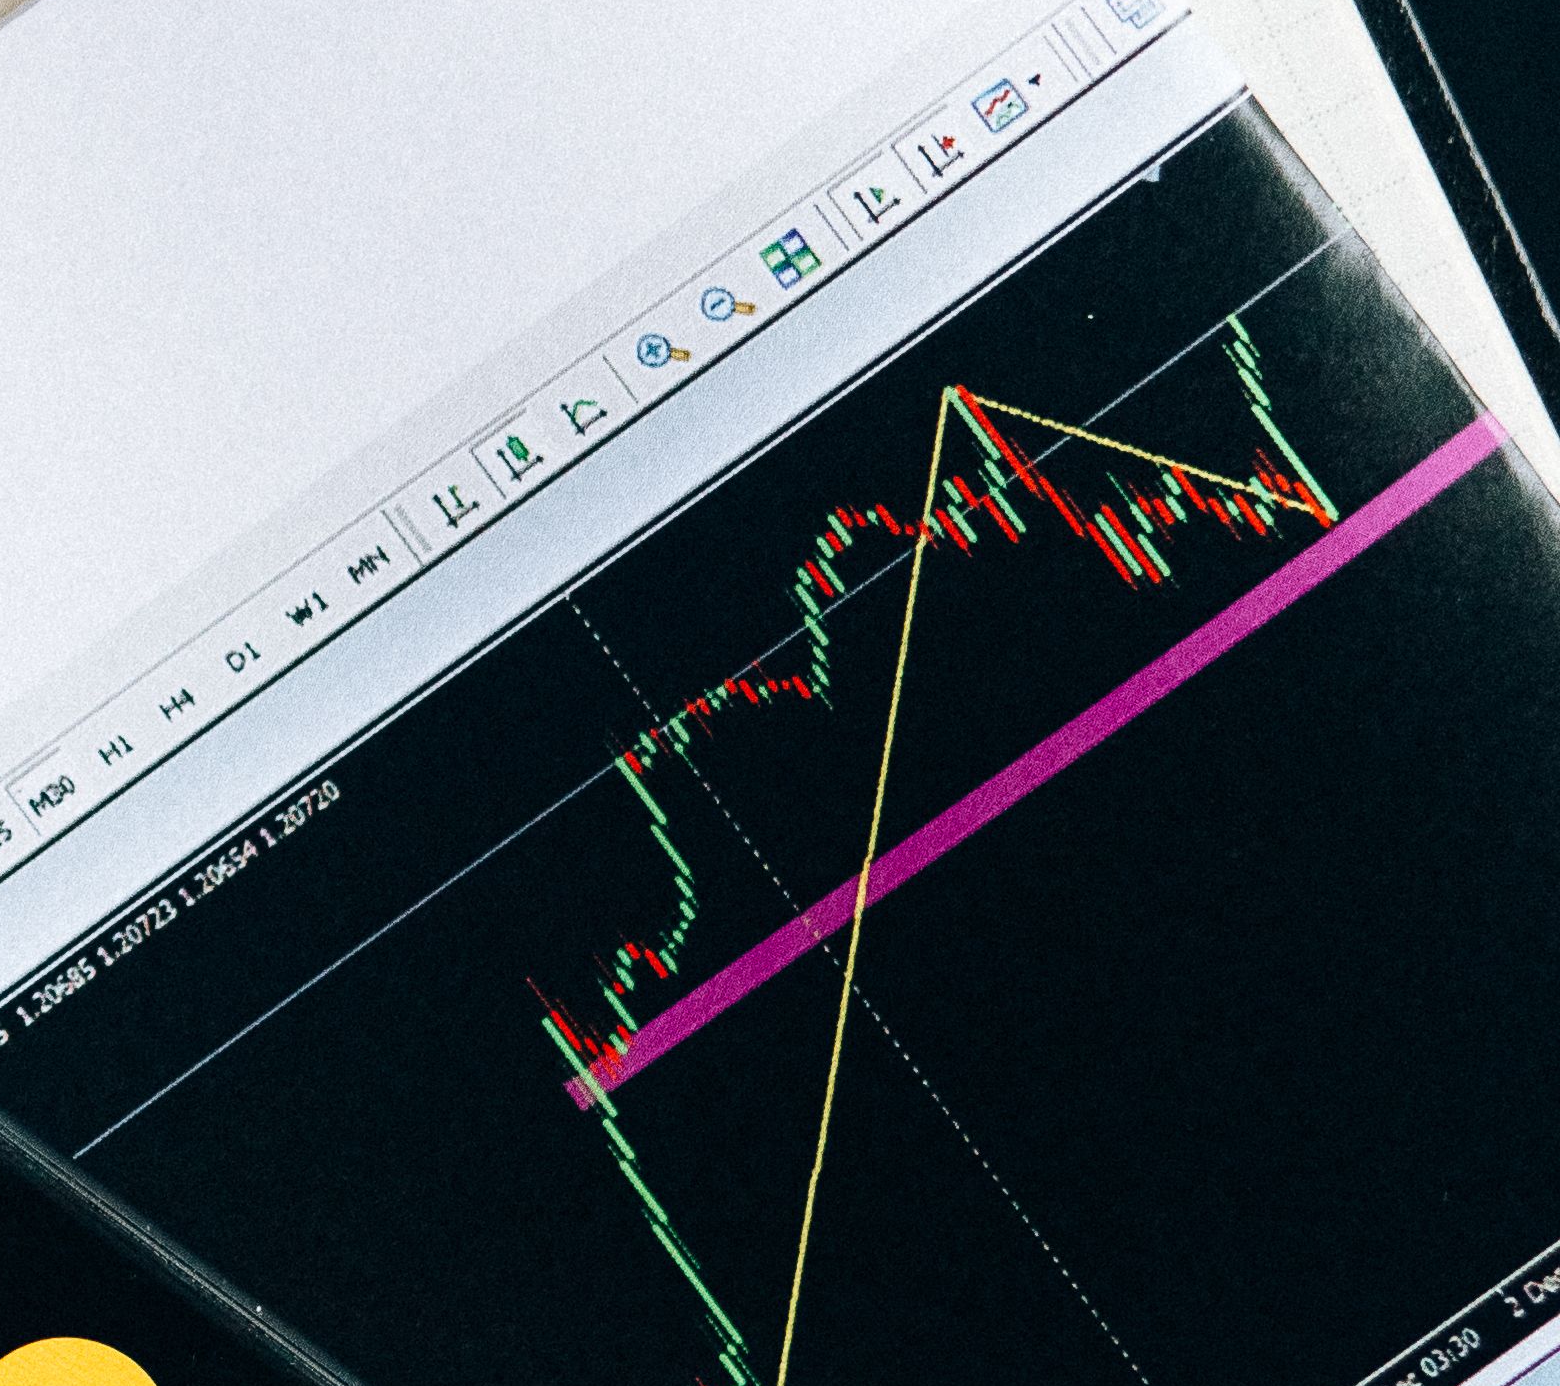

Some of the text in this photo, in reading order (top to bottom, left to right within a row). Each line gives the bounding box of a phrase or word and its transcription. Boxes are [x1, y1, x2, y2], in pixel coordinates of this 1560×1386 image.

[28, 775, 76, 818] M30
[97, 735, 134, 766] H1
[158, 688, 196, 721] H4
[224, 641, 262, 674] D1
[285, 591, 329, 627] W1
[347, 545, 391, 585] MN
[16, 956, 97, 1027] 1.20685
[96, 898, 178, 967] 1.20723
[177, 839, 259, 907] 1.20654
[259, 779, 341, 848] 1.20720
[1419, 1327, 1481, 1378] 03:30
[1503, 1296, 1526, 1318] 2
